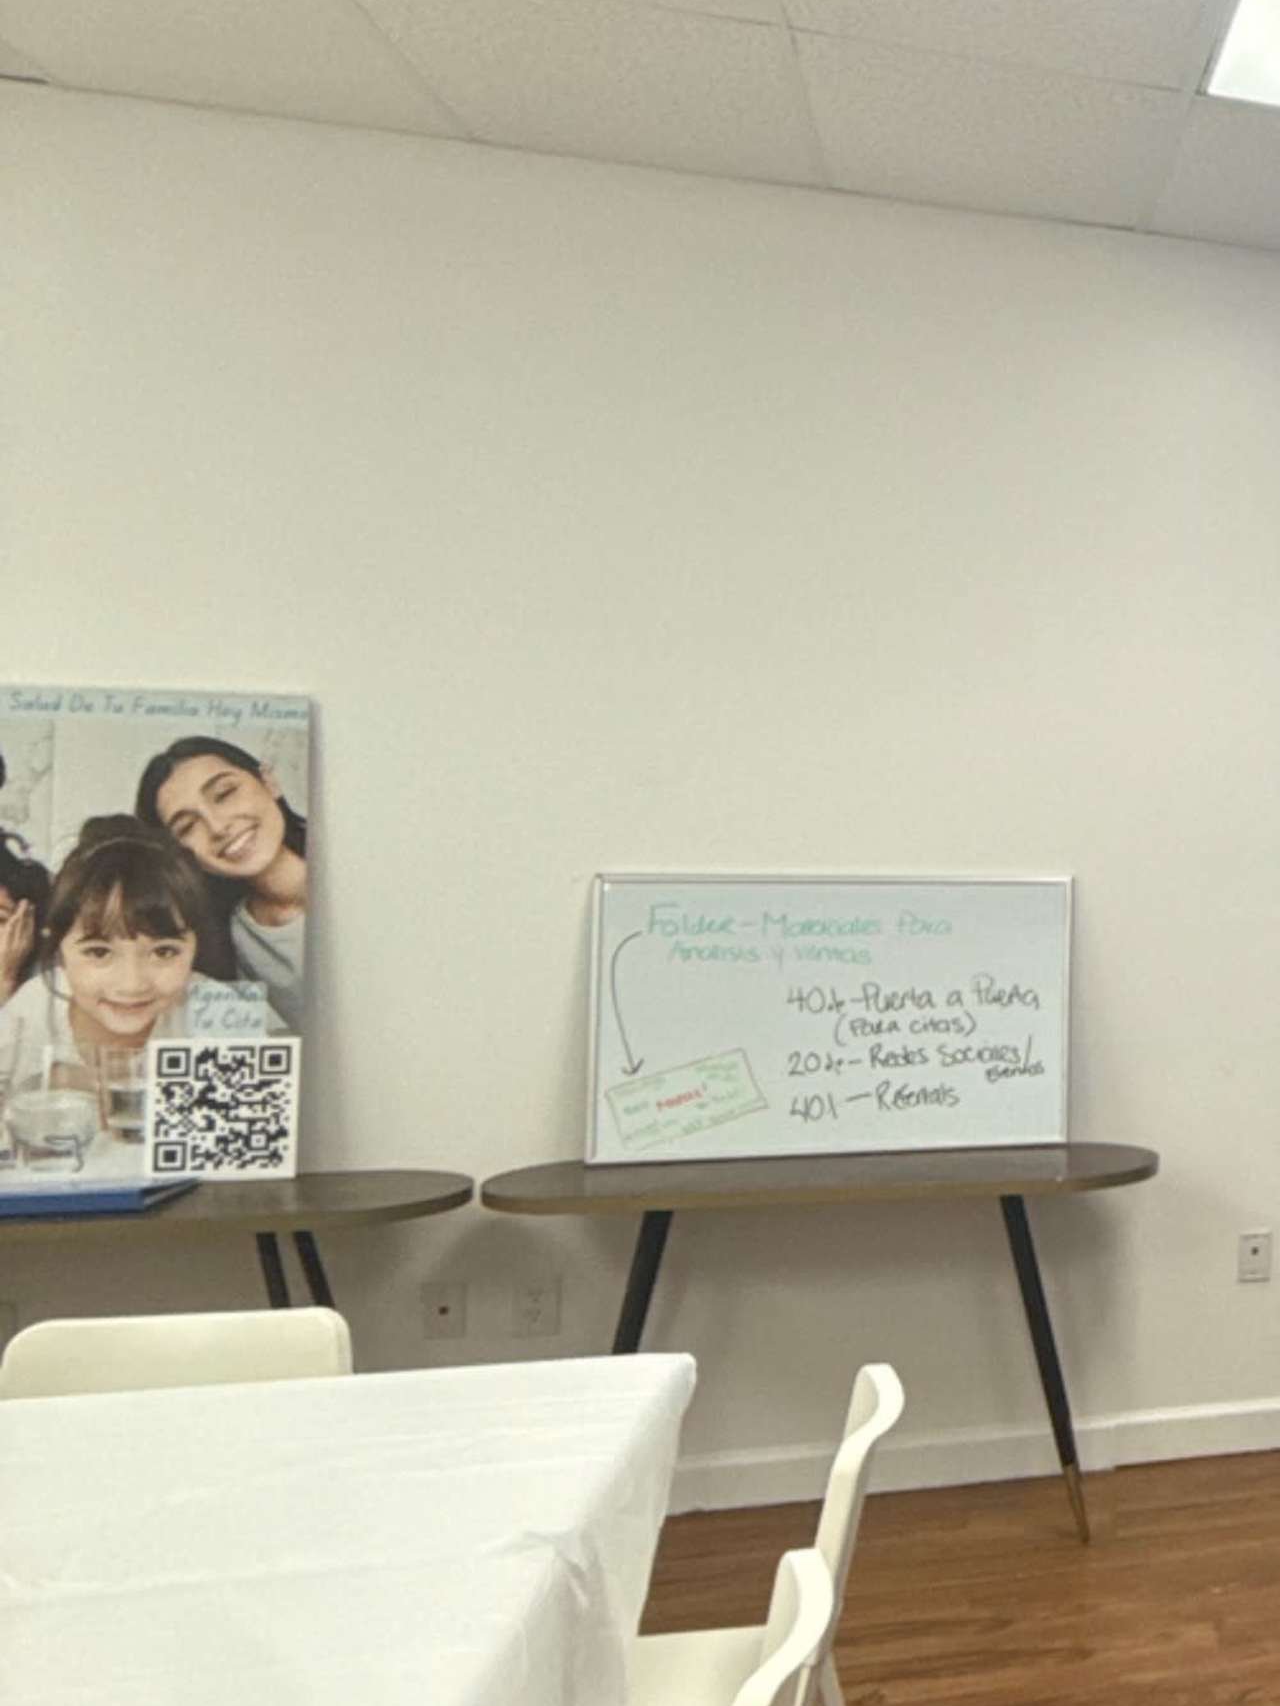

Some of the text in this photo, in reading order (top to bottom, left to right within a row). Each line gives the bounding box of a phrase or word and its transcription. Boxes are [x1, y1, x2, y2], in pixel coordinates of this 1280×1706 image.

[7, 690, 62, 711] Salud
[69, 691, 94, 713] De
[103, 692, 123, 714] Tu
[131, 694, 200, 717] Familia
[207, 698, 242, 723] Hoy
[946, 991, 964, 1008] a
